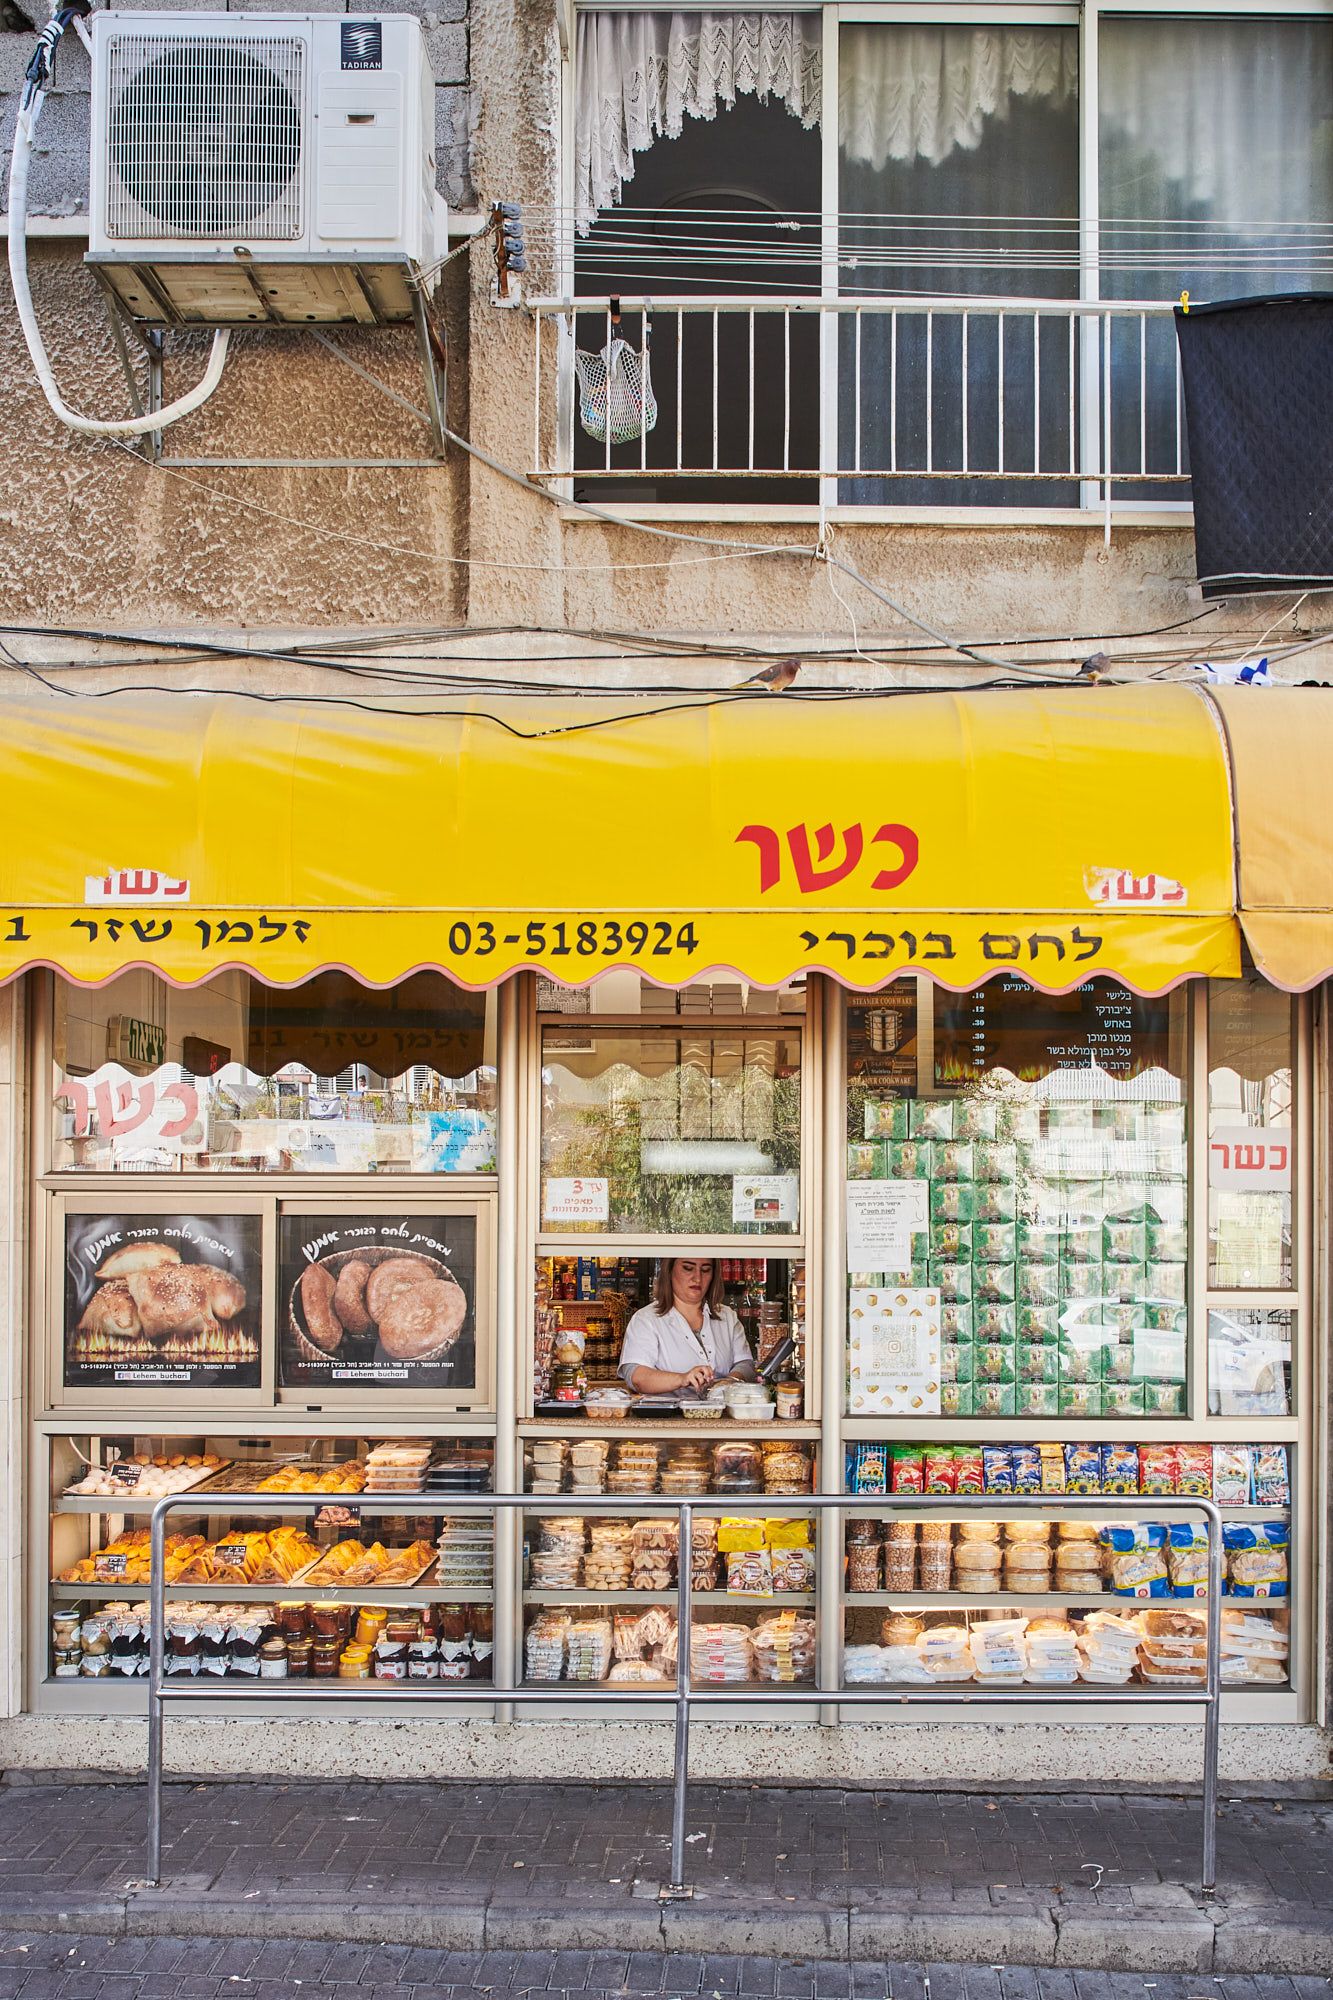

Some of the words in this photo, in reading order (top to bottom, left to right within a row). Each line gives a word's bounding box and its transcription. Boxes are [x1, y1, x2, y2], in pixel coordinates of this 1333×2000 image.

[342, 61, 382, 69] TADIRAN
[734, 822, 919, 894] כשר
[70, 918, 173, 943] שזר
[195, 915, 312, 950] זלמן
[448, 920, 699, 956] 03-5183924
[978, 925, 1103, 962] לחם
[799, 930, 957, 961] בוכרי
[880, 997, 913, 1005] COOKWARE
[1105, 989, 1132, 1001] בלישי
[1103, 1019, 1132, 1029] באחש
[129, 1017, 165, 1066] יציאה
[1086, 1033, 1108, 1044] מוכן
[1109, 1033, 1132, 1043] מנטו
[1046, 1046, 1066, 1055] בשר
[1099, 1046, 1114, 1058] גפן
[1115, 1045, 1132, 1056] עלי
[1110, 1061, 1132, 1070] כרוב
[878, 1076, 912, 1084] COOKWARE
[54, 1080, 199, 1138] כשר
[1211, 1144, 1287, 1171] כשר
[572, 1180, 584, 1194] 3
[126, 1227, 160, 1238] הבוכרי
[163, 1222, 193, 1240] הלחם
[343, 1226, 377, 1237] הבוכרי
[380, 1221, 410, 1239] הלחם
[191, 1234, 235, 1258] מאפיית
[409, 1233, 453, 1257] מאפיית
